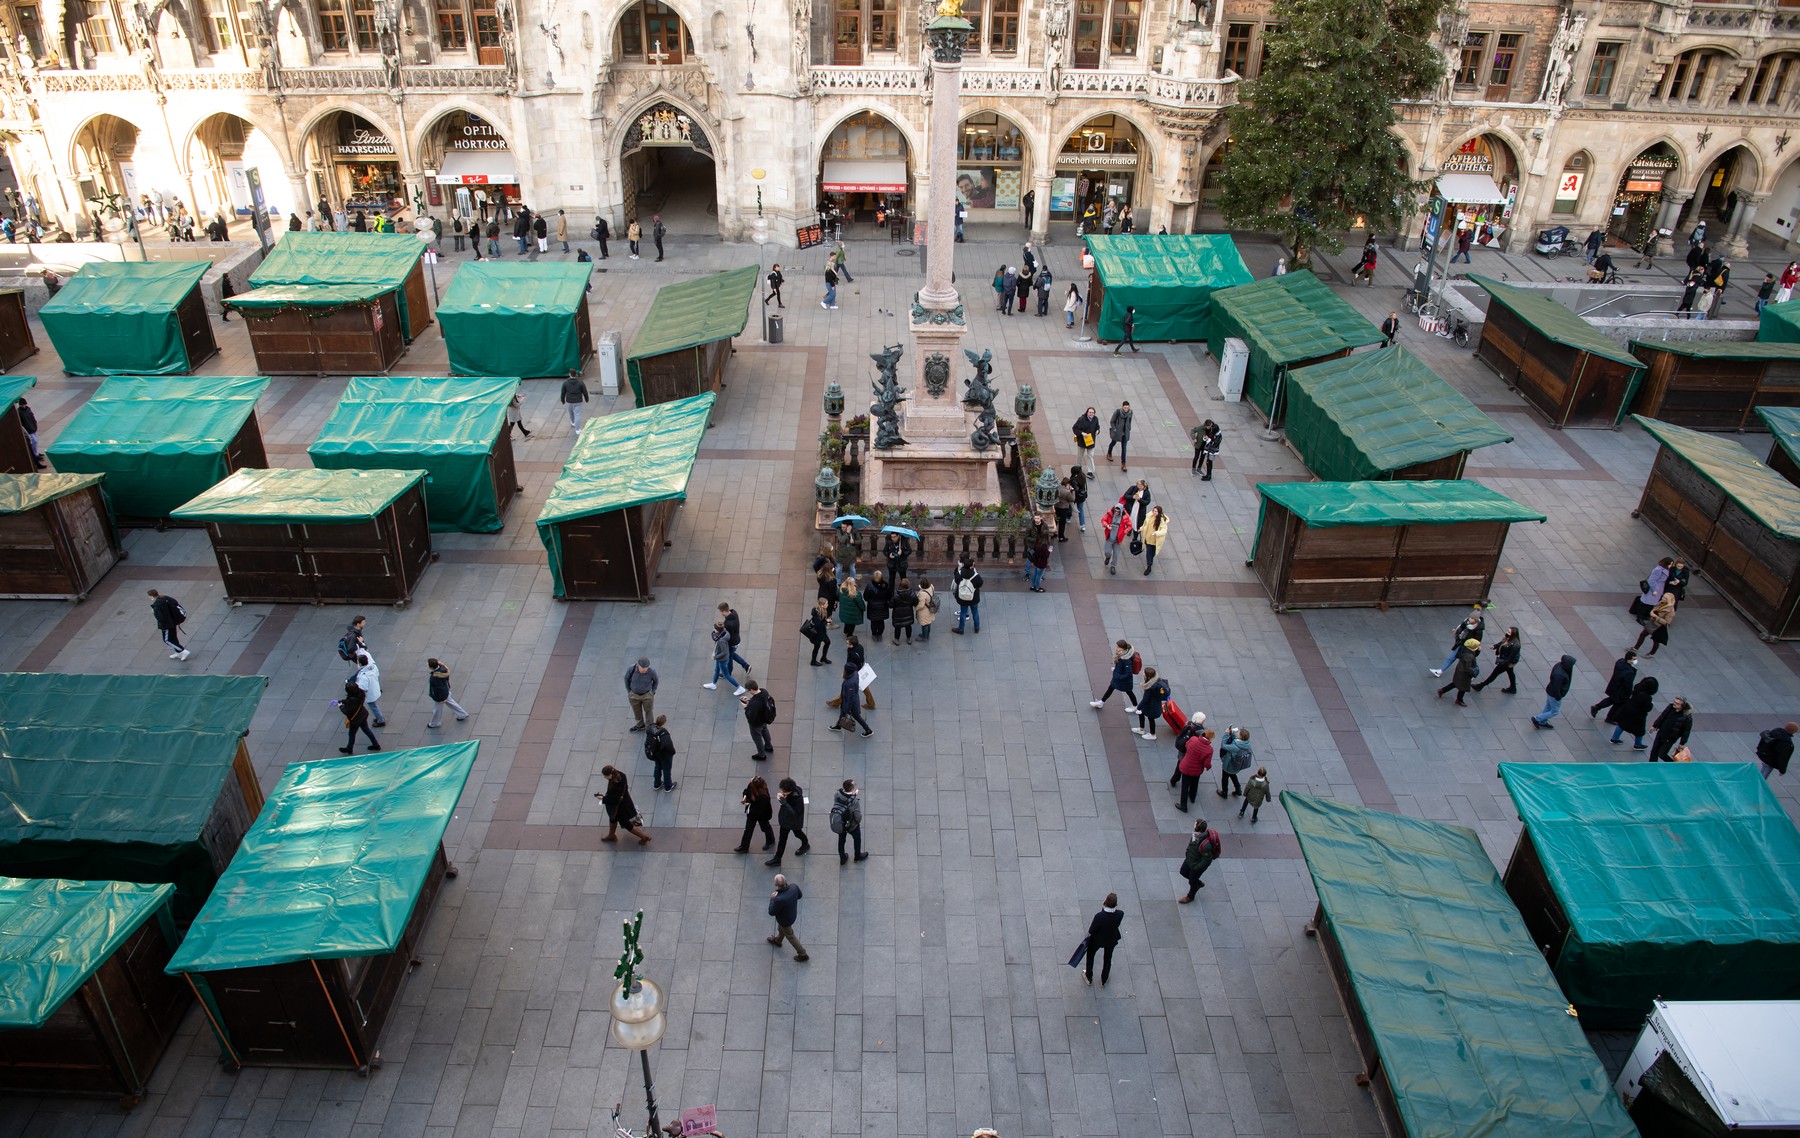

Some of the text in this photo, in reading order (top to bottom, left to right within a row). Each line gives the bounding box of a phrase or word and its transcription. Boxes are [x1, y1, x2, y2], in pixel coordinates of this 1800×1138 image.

[338, 145, 394, 154] HAARSCHMU
[454, 138, 510, 149] HÖRTKOR
[1092, 156, 1137, 165] Information
[1445, 154, 1489, 164] ATHAUS
[1440, 162, 1493, 172] POTHEKE
[252, 170, 260, 185] S
[256, 188, 263, 203] U
[1433, 199, 1441, 215] S
[1430, 217, 1437, 233] U
[1654, 1016, 1682, 1064] Steingadener
